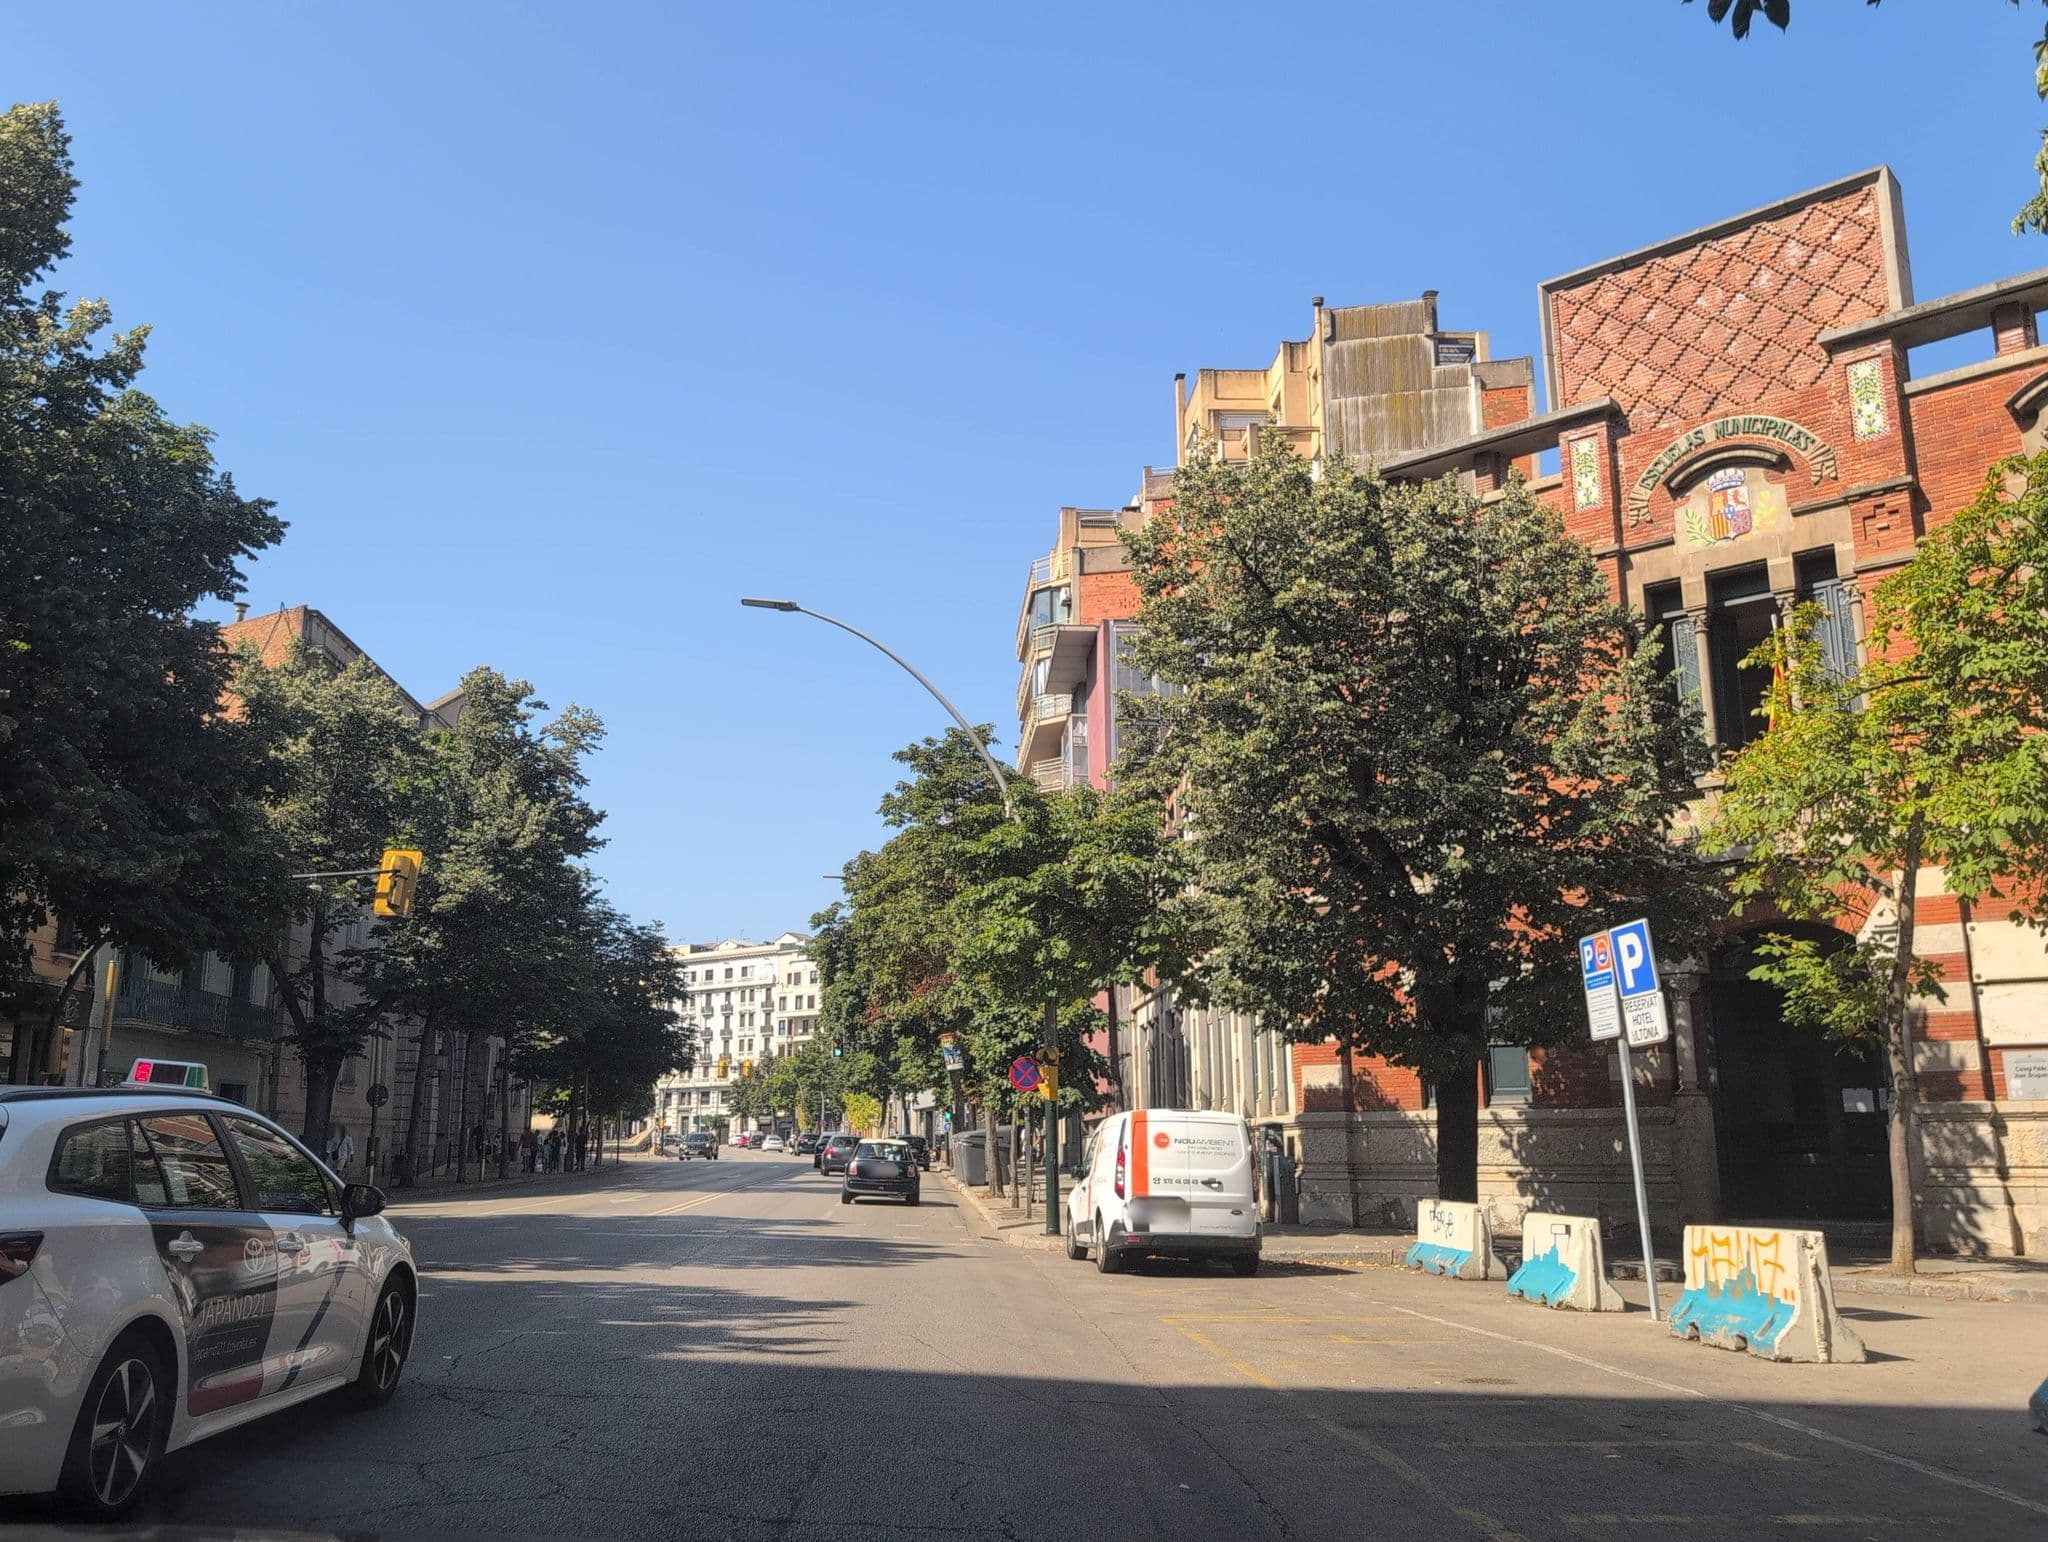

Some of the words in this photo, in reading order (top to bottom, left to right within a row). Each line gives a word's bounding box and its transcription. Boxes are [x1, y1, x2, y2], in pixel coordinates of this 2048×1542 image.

[1640, 430, 1706, 490] ESCUELAS
[1715, 417, 1816, 451] MUNICIPALES
[1583, 944, 1594, 970] P
[1617, 932, 1643, 989] P
[1624, 996, 1658, 1012] RESERVAT
[1632, 1013, 1654, 1026] HOTEL
[1631, 1029, 1660, 1043] ULTONIA
[1174, 1137, 1236, 1147] NOUAMBIENT
[198, 1292, 266, 1328] JAPAND21
